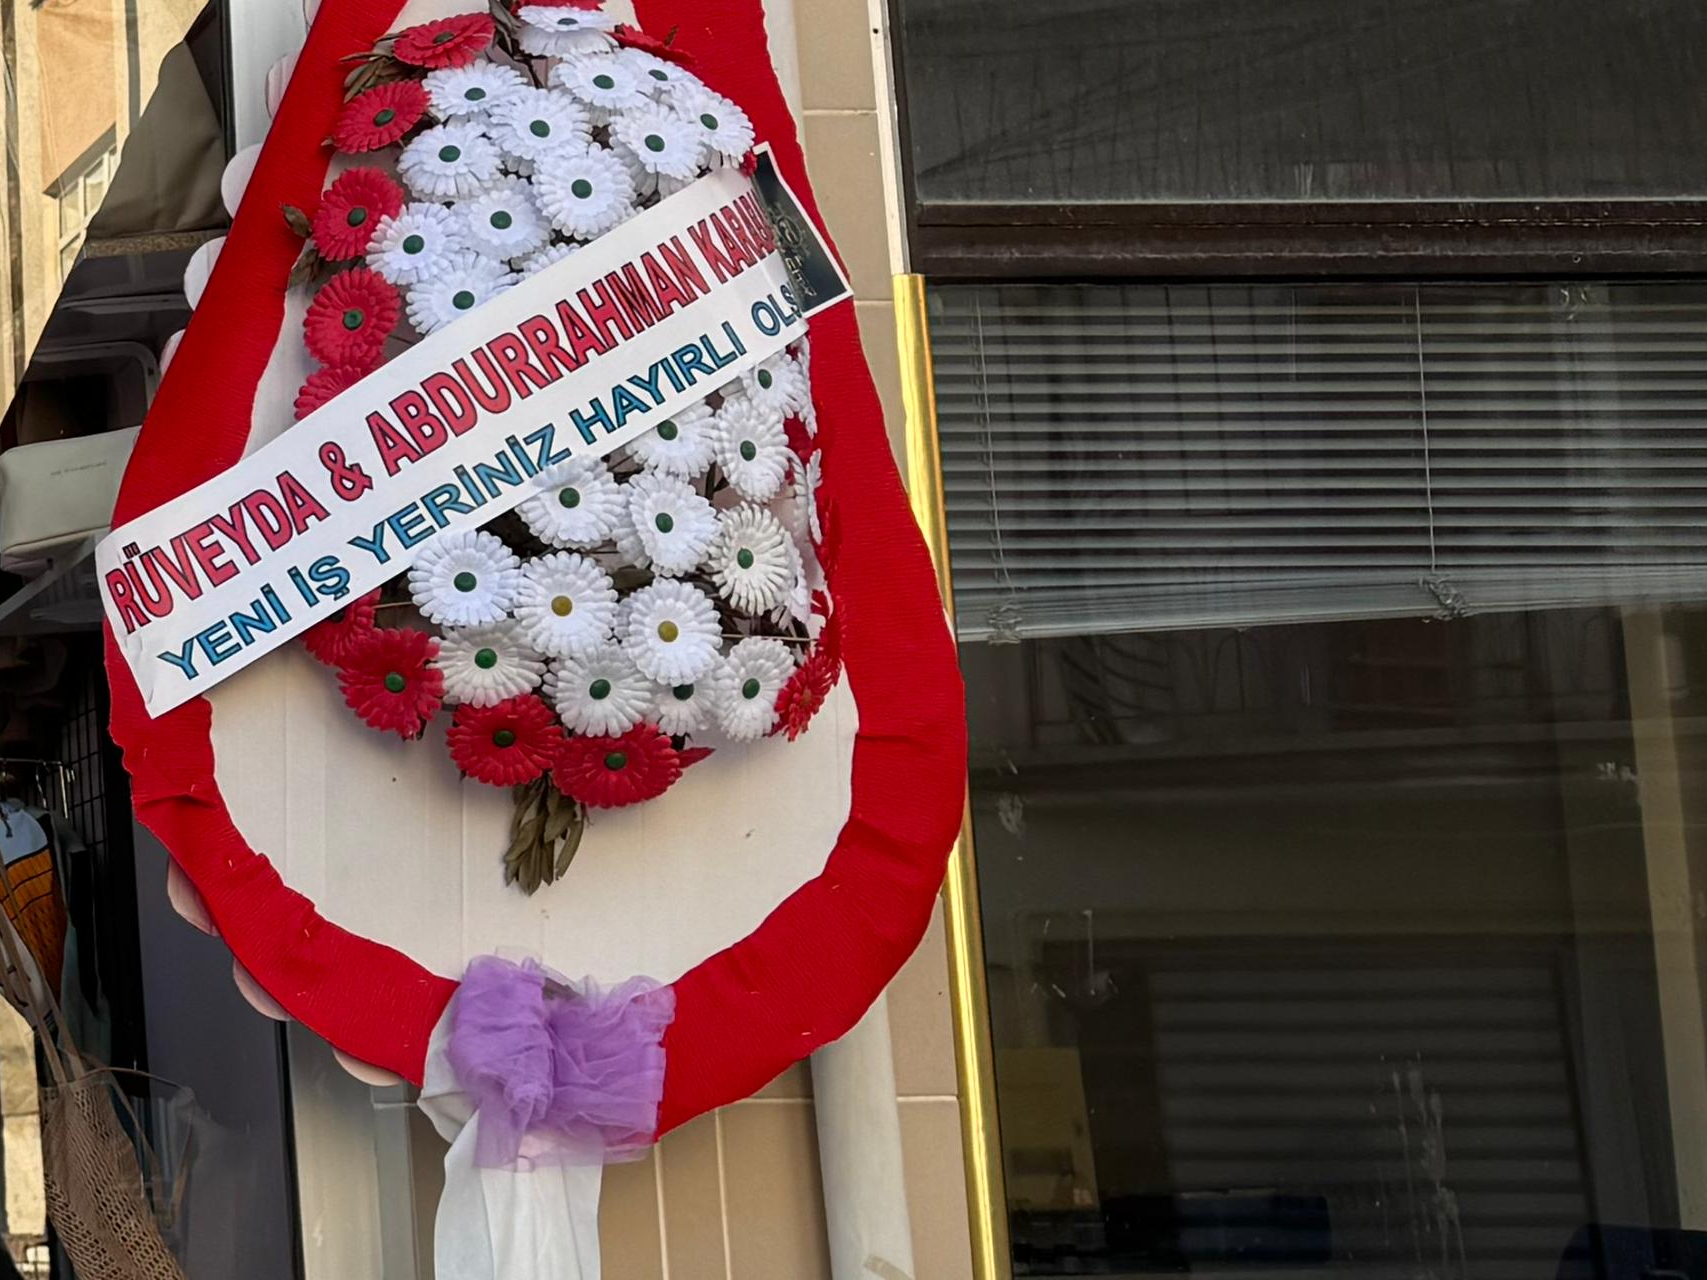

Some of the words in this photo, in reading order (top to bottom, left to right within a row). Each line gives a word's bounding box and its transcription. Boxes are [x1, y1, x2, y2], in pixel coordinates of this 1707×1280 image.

[109, 471, 329, 634] RÜVEYDA
[318, 441, 373, 500] &
[366, 235, 716, 478] ABDURRAHMAN
[158, 587, 292, 680] YENİ
[293, 554, 351, 606] İŞ
[348, 422, 572, 568] YERİNİZ
[571, 324, 747, 447] HAYIRLI
